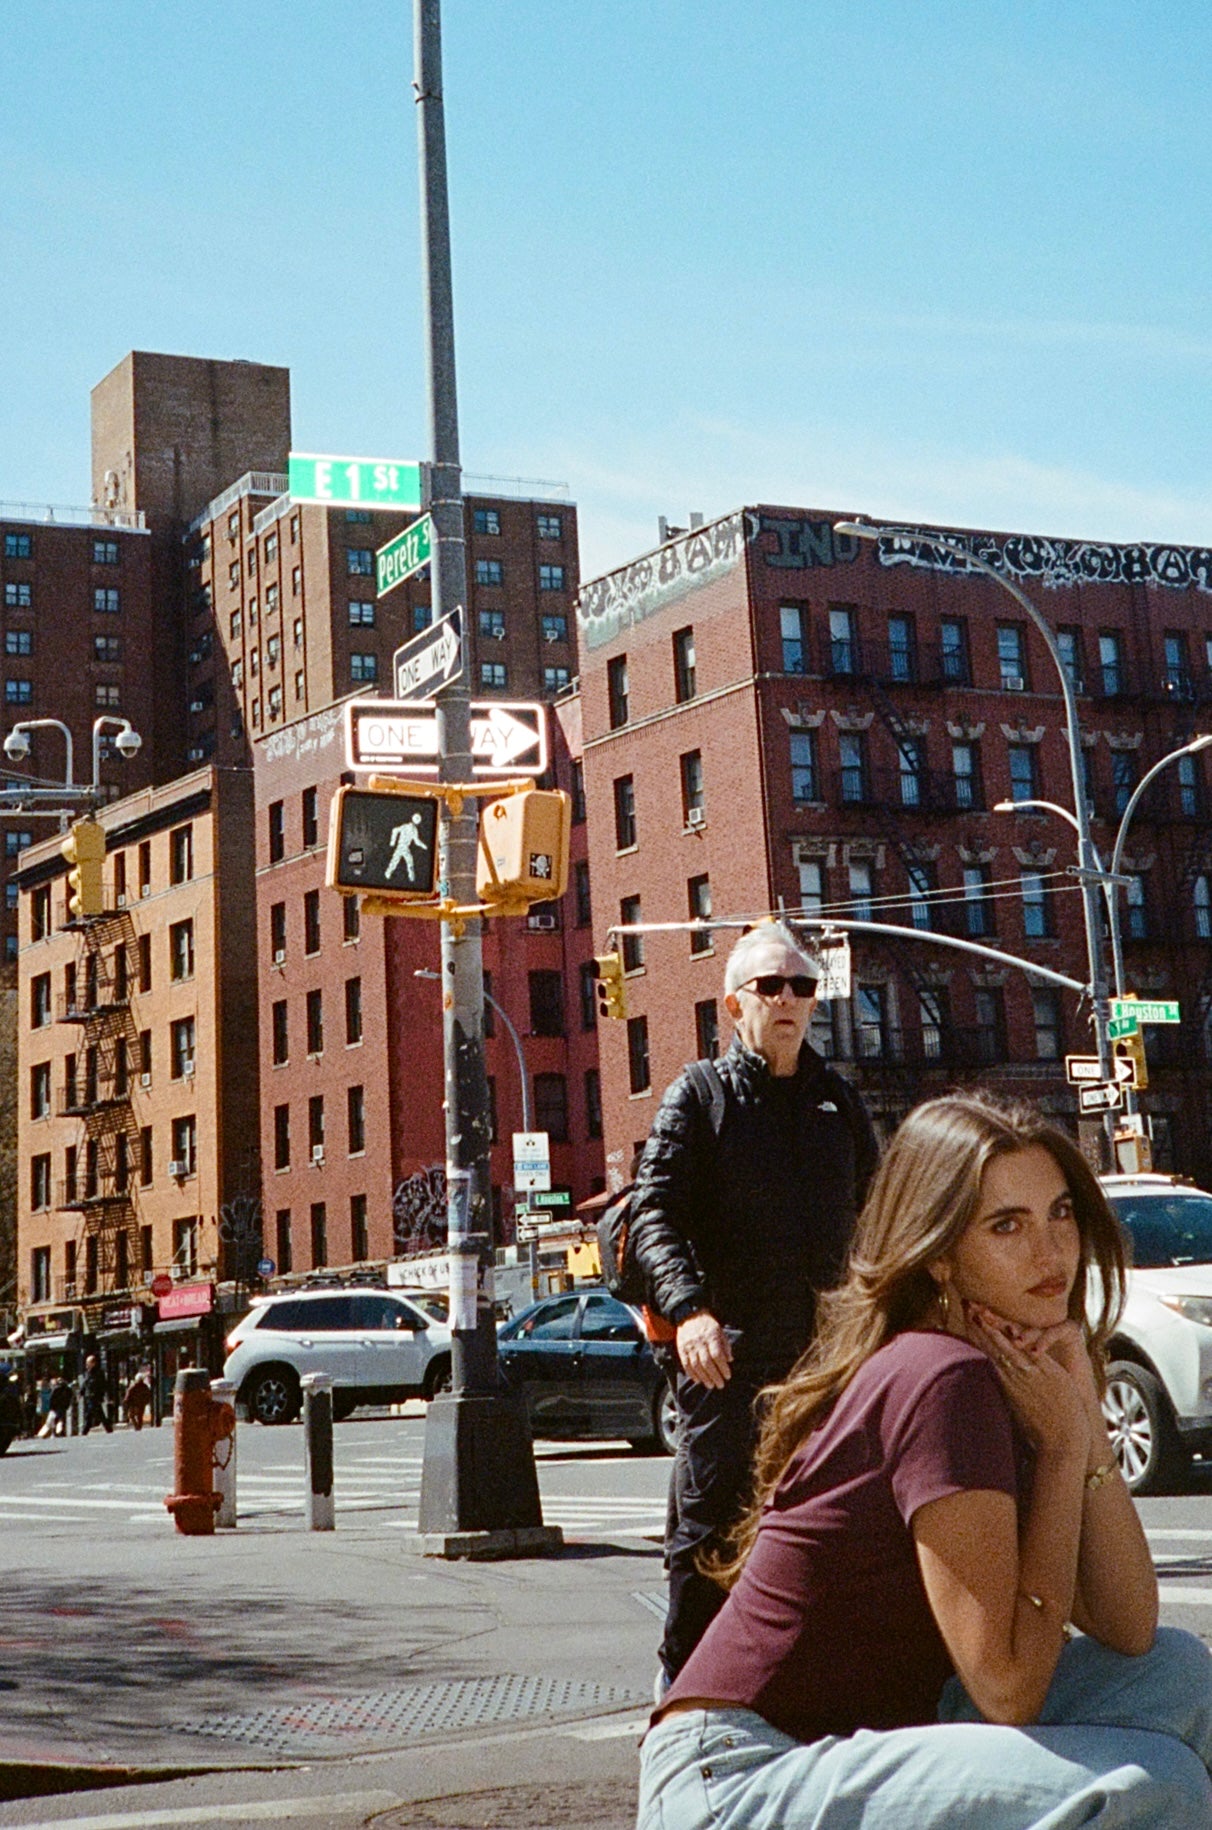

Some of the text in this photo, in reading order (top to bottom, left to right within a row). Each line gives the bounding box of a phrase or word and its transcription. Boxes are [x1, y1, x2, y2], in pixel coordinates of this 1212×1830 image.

[315, 461, 399, 500] E 1 St
[379, 533, 420, 589] Peretz
[400, 636, 452, 691] ONE WAY
[367, 724, 423, 748] ONE
[472, 727, 514, 749] AY
[1122, 1003, 1166, 1020] Houston
